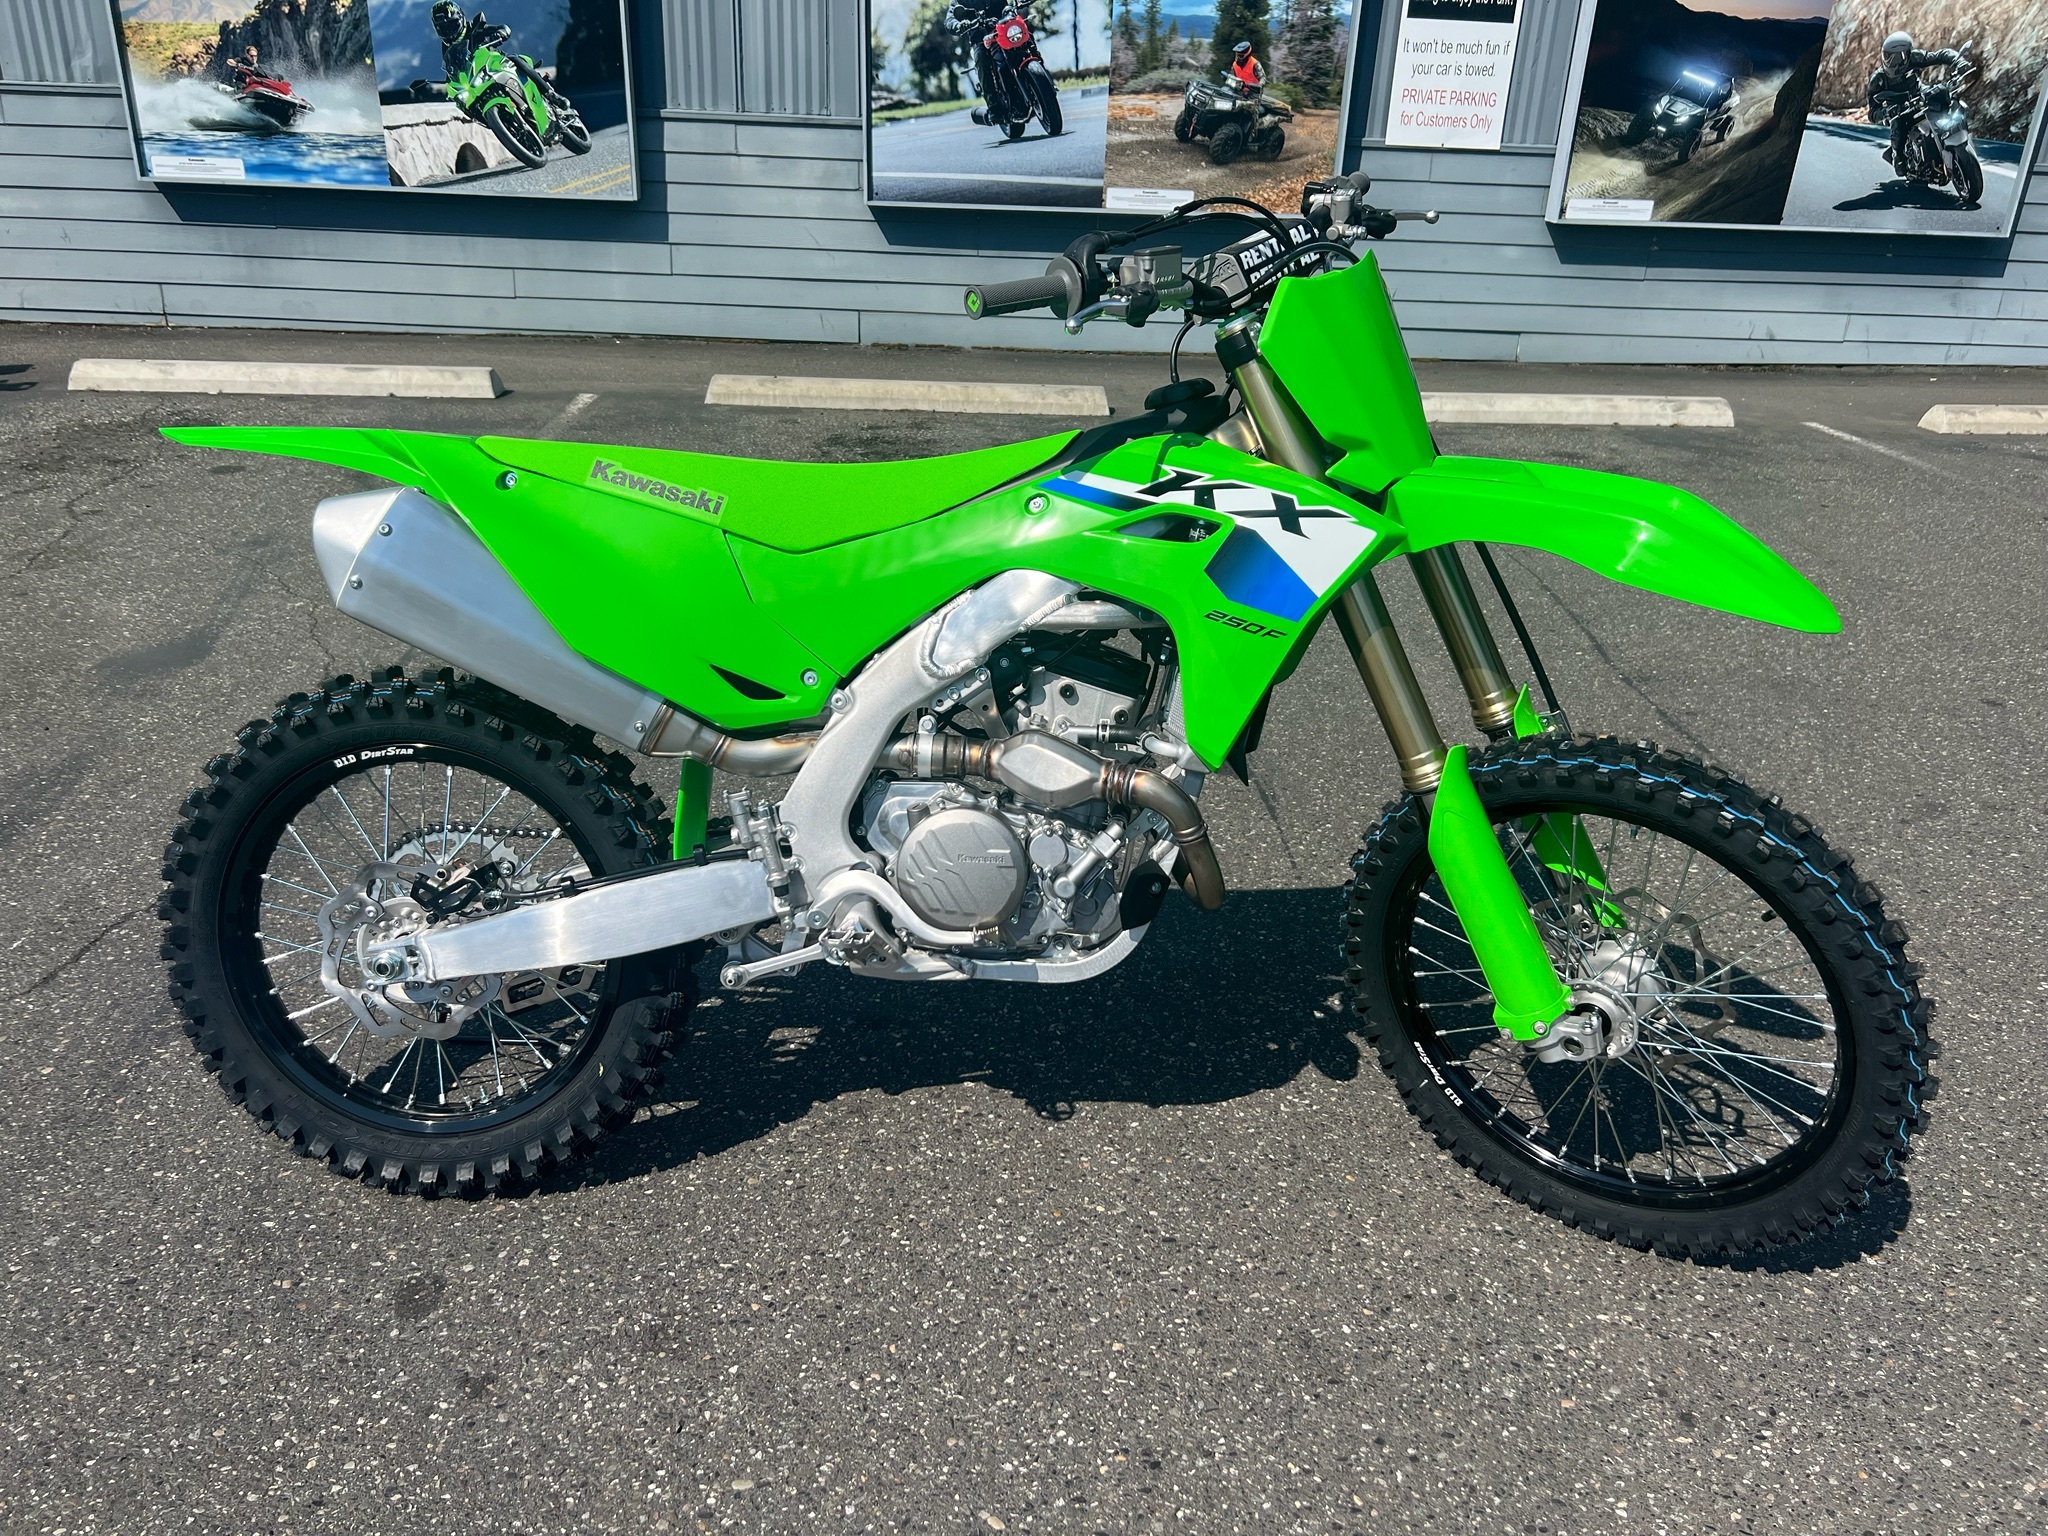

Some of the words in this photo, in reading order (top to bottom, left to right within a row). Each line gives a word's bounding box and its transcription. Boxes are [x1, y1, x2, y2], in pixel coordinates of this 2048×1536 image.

[1403, 37, 1410, 53] It
[1412, 38, 1438, 54] won't
[1440, 39, 1453, 54] be
[1455, 40, 1483, 56] much
[1485, 39, 1501, 56] fun
[1502, 40, 1511, 56] if
[1411, 62, 1434, 79] your
[1435, 63, 1452, 76] car
[1454, 60, 1462, 76] is
[1464, 62, 1496, 77] towed.
[1401, 88, 1447, 106] PRIVATE
[1449, 90, 1498, 108] PARKING
[1400, 110, 1413, 127] for
[1415, 111, 1468, 129] Customers
[1470, 113, 1493, 133] Only
[1239, 224, 1312, 271] RENTAL
[589, 459, 725, 516] Kawasaki
[1203, 609, 1288, 640] 250F
[957, 853, 1006, 864] Kawasaki
